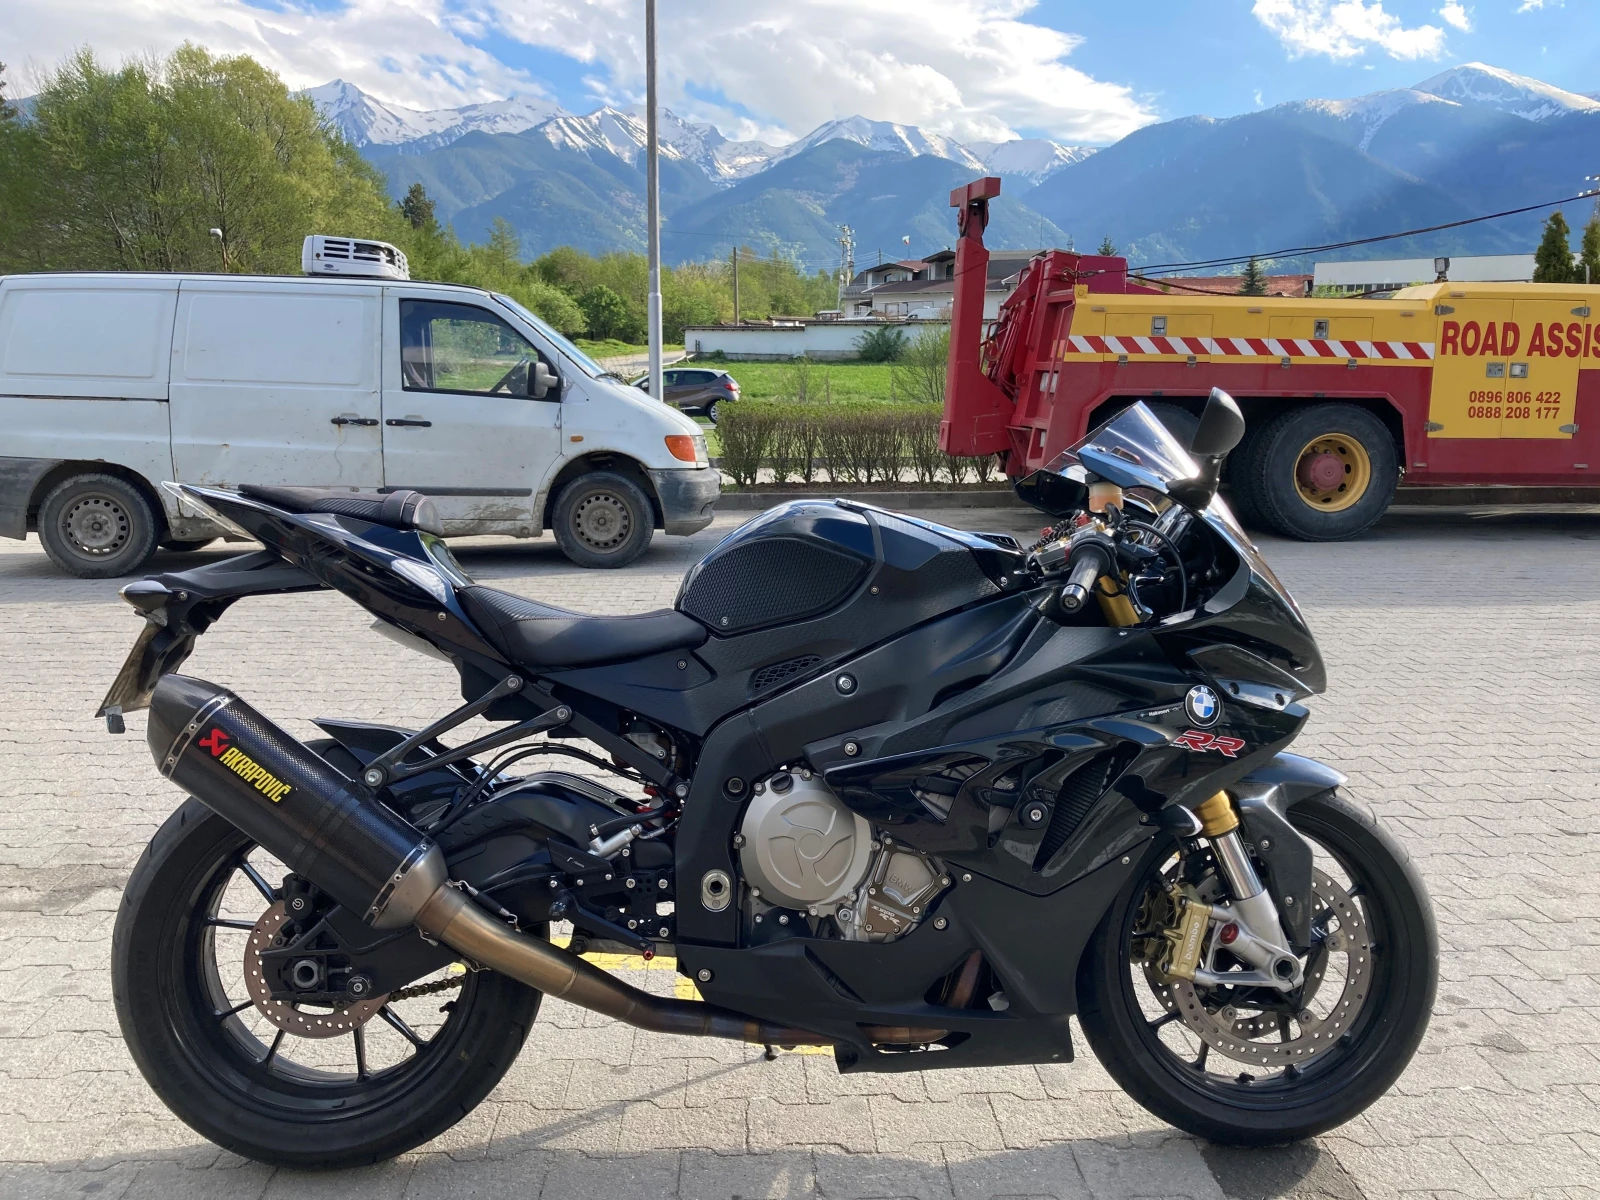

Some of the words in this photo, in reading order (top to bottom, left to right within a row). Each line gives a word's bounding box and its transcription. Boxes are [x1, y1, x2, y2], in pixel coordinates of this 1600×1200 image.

[1440, 320, 1520, 356] ROAD
[1469, 391, 1502, 404] 0896
[1506, 391, 1532, 404] 806
[1535, 392, 1561, 404] 422
[1468, 406, 1502, 419] 0888
[1505, 407, 1531, 419] 208
[1535, 407, 1560, 419] 177
[1173, 730, 1246, 758] RR
[890, 874, 914, 892] BMW
[1183, 922, 1200, 961] brembo
